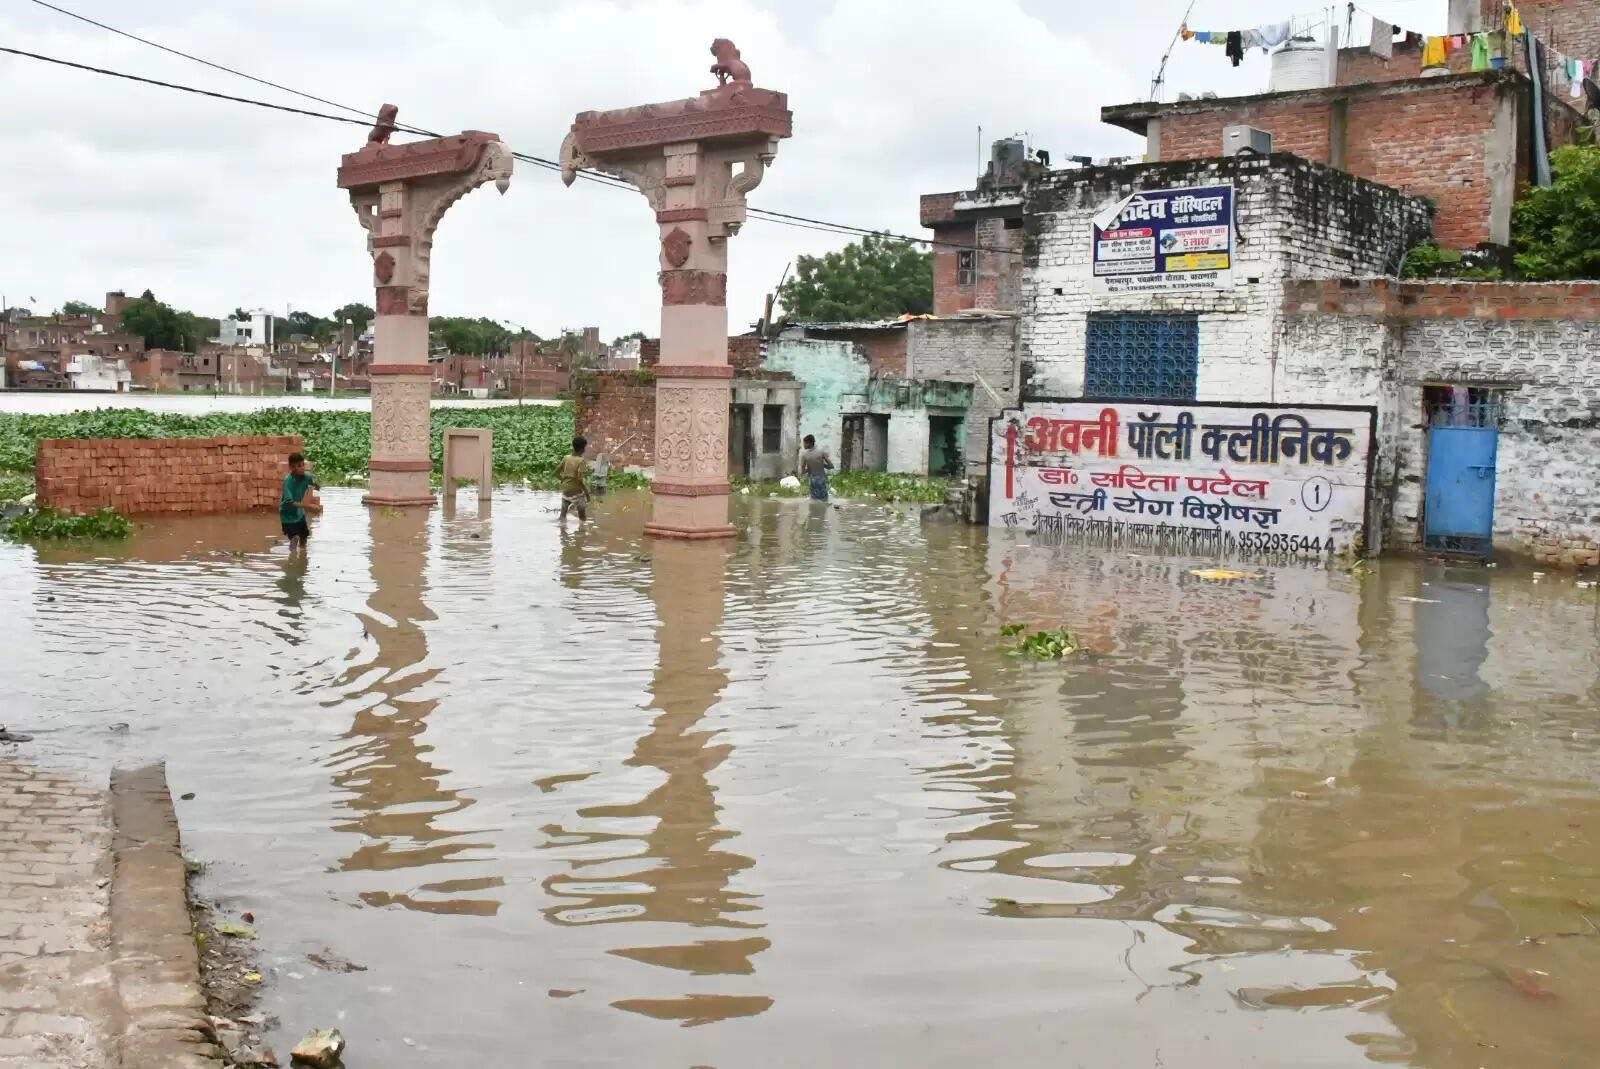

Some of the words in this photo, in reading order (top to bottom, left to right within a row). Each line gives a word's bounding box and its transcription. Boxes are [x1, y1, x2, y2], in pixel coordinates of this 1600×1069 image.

[1170, 195, 1223, 214] हॉस्पिटल
[1190, 237, 1210, 246] लाख
[1024, 407, 1120, 458] अवनी
[1127, 411, 1196, 460] पॉली
[1201, 412, 1353, 465] क्लीनिक
[1090, 464, 1180, 492] सरिता
[1185, 467, 1270, 499] पटेल
[1048, 488, 1108, 515] स्त्री
[1113, 490, 1174, 517] रोग
[1180, 495, 1282, 530] विशेषज्ञ
[1239, 531, 1336, 554] 9532935444
